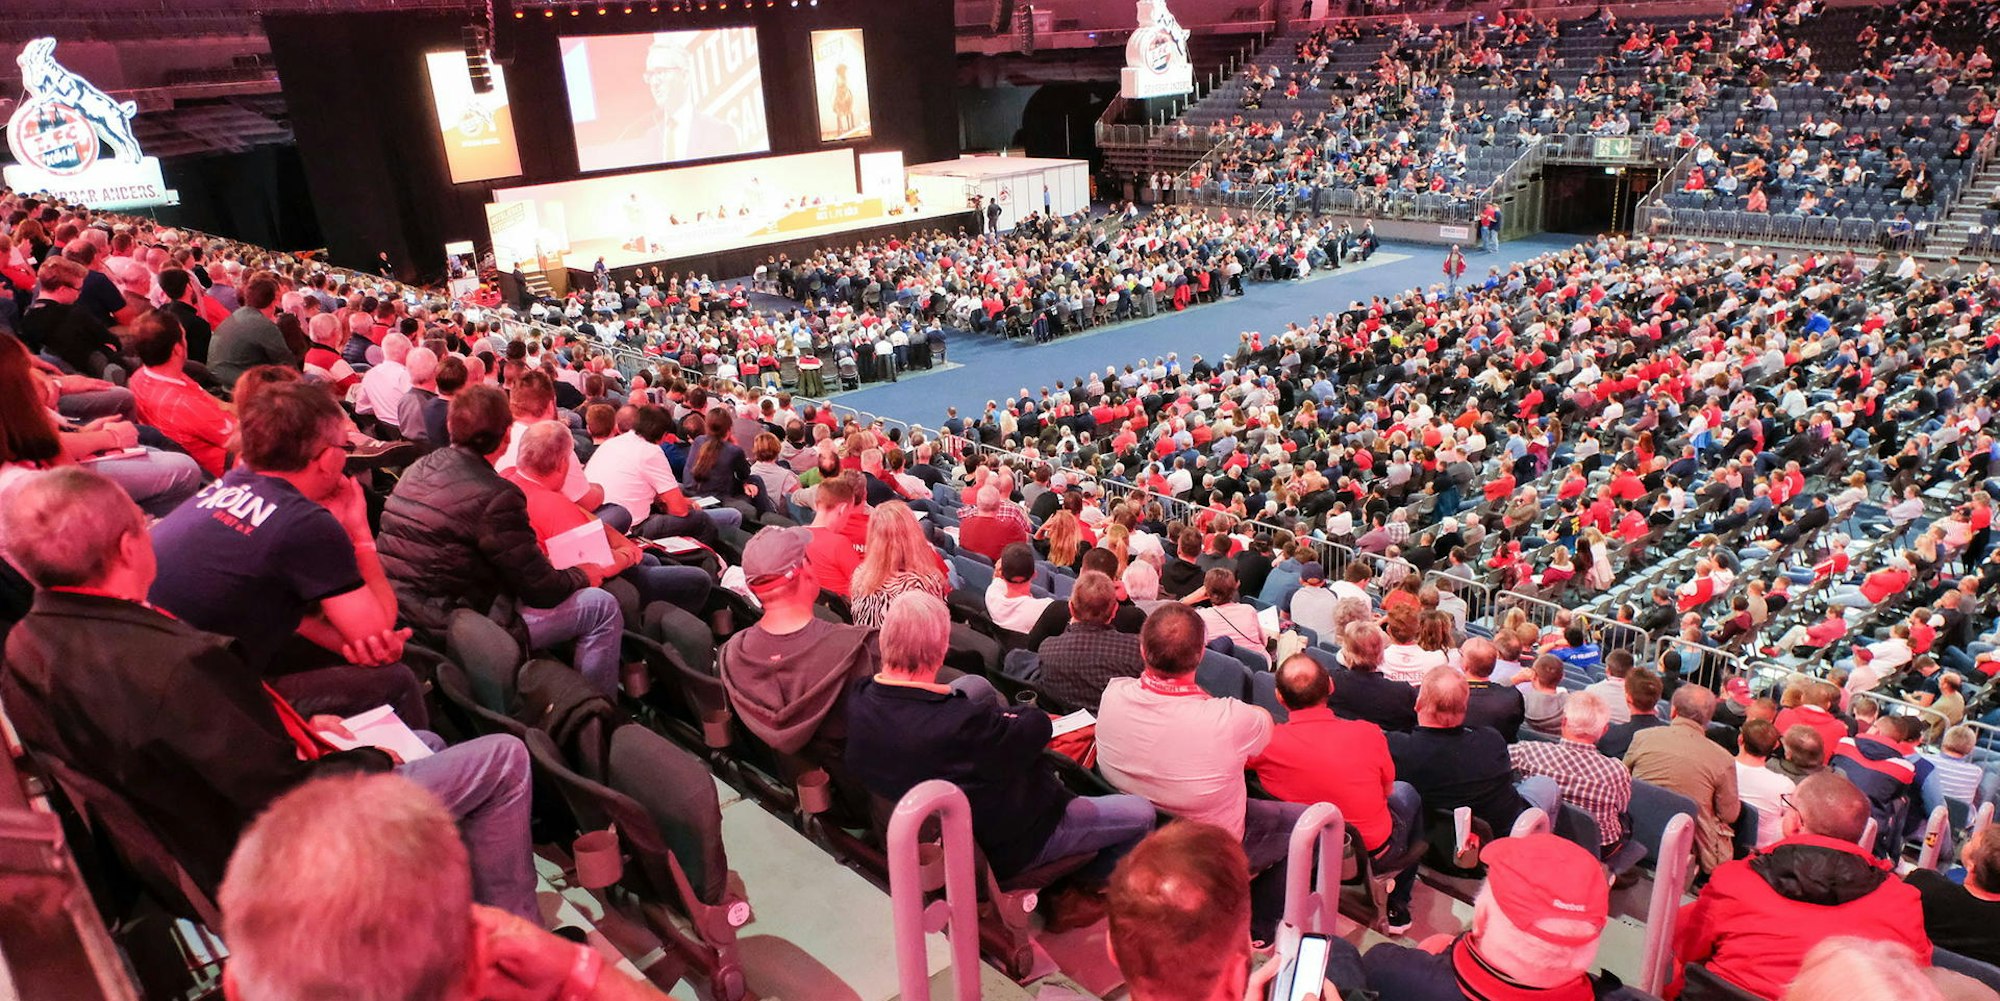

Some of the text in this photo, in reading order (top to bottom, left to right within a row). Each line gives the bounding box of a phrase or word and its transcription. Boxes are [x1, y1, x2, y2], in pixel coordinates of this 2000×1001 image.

[53, 125, 77, 144] FC
[196, 484, 278, 527] KÖLN
[1553, 899, 1586, 912] Reebok
